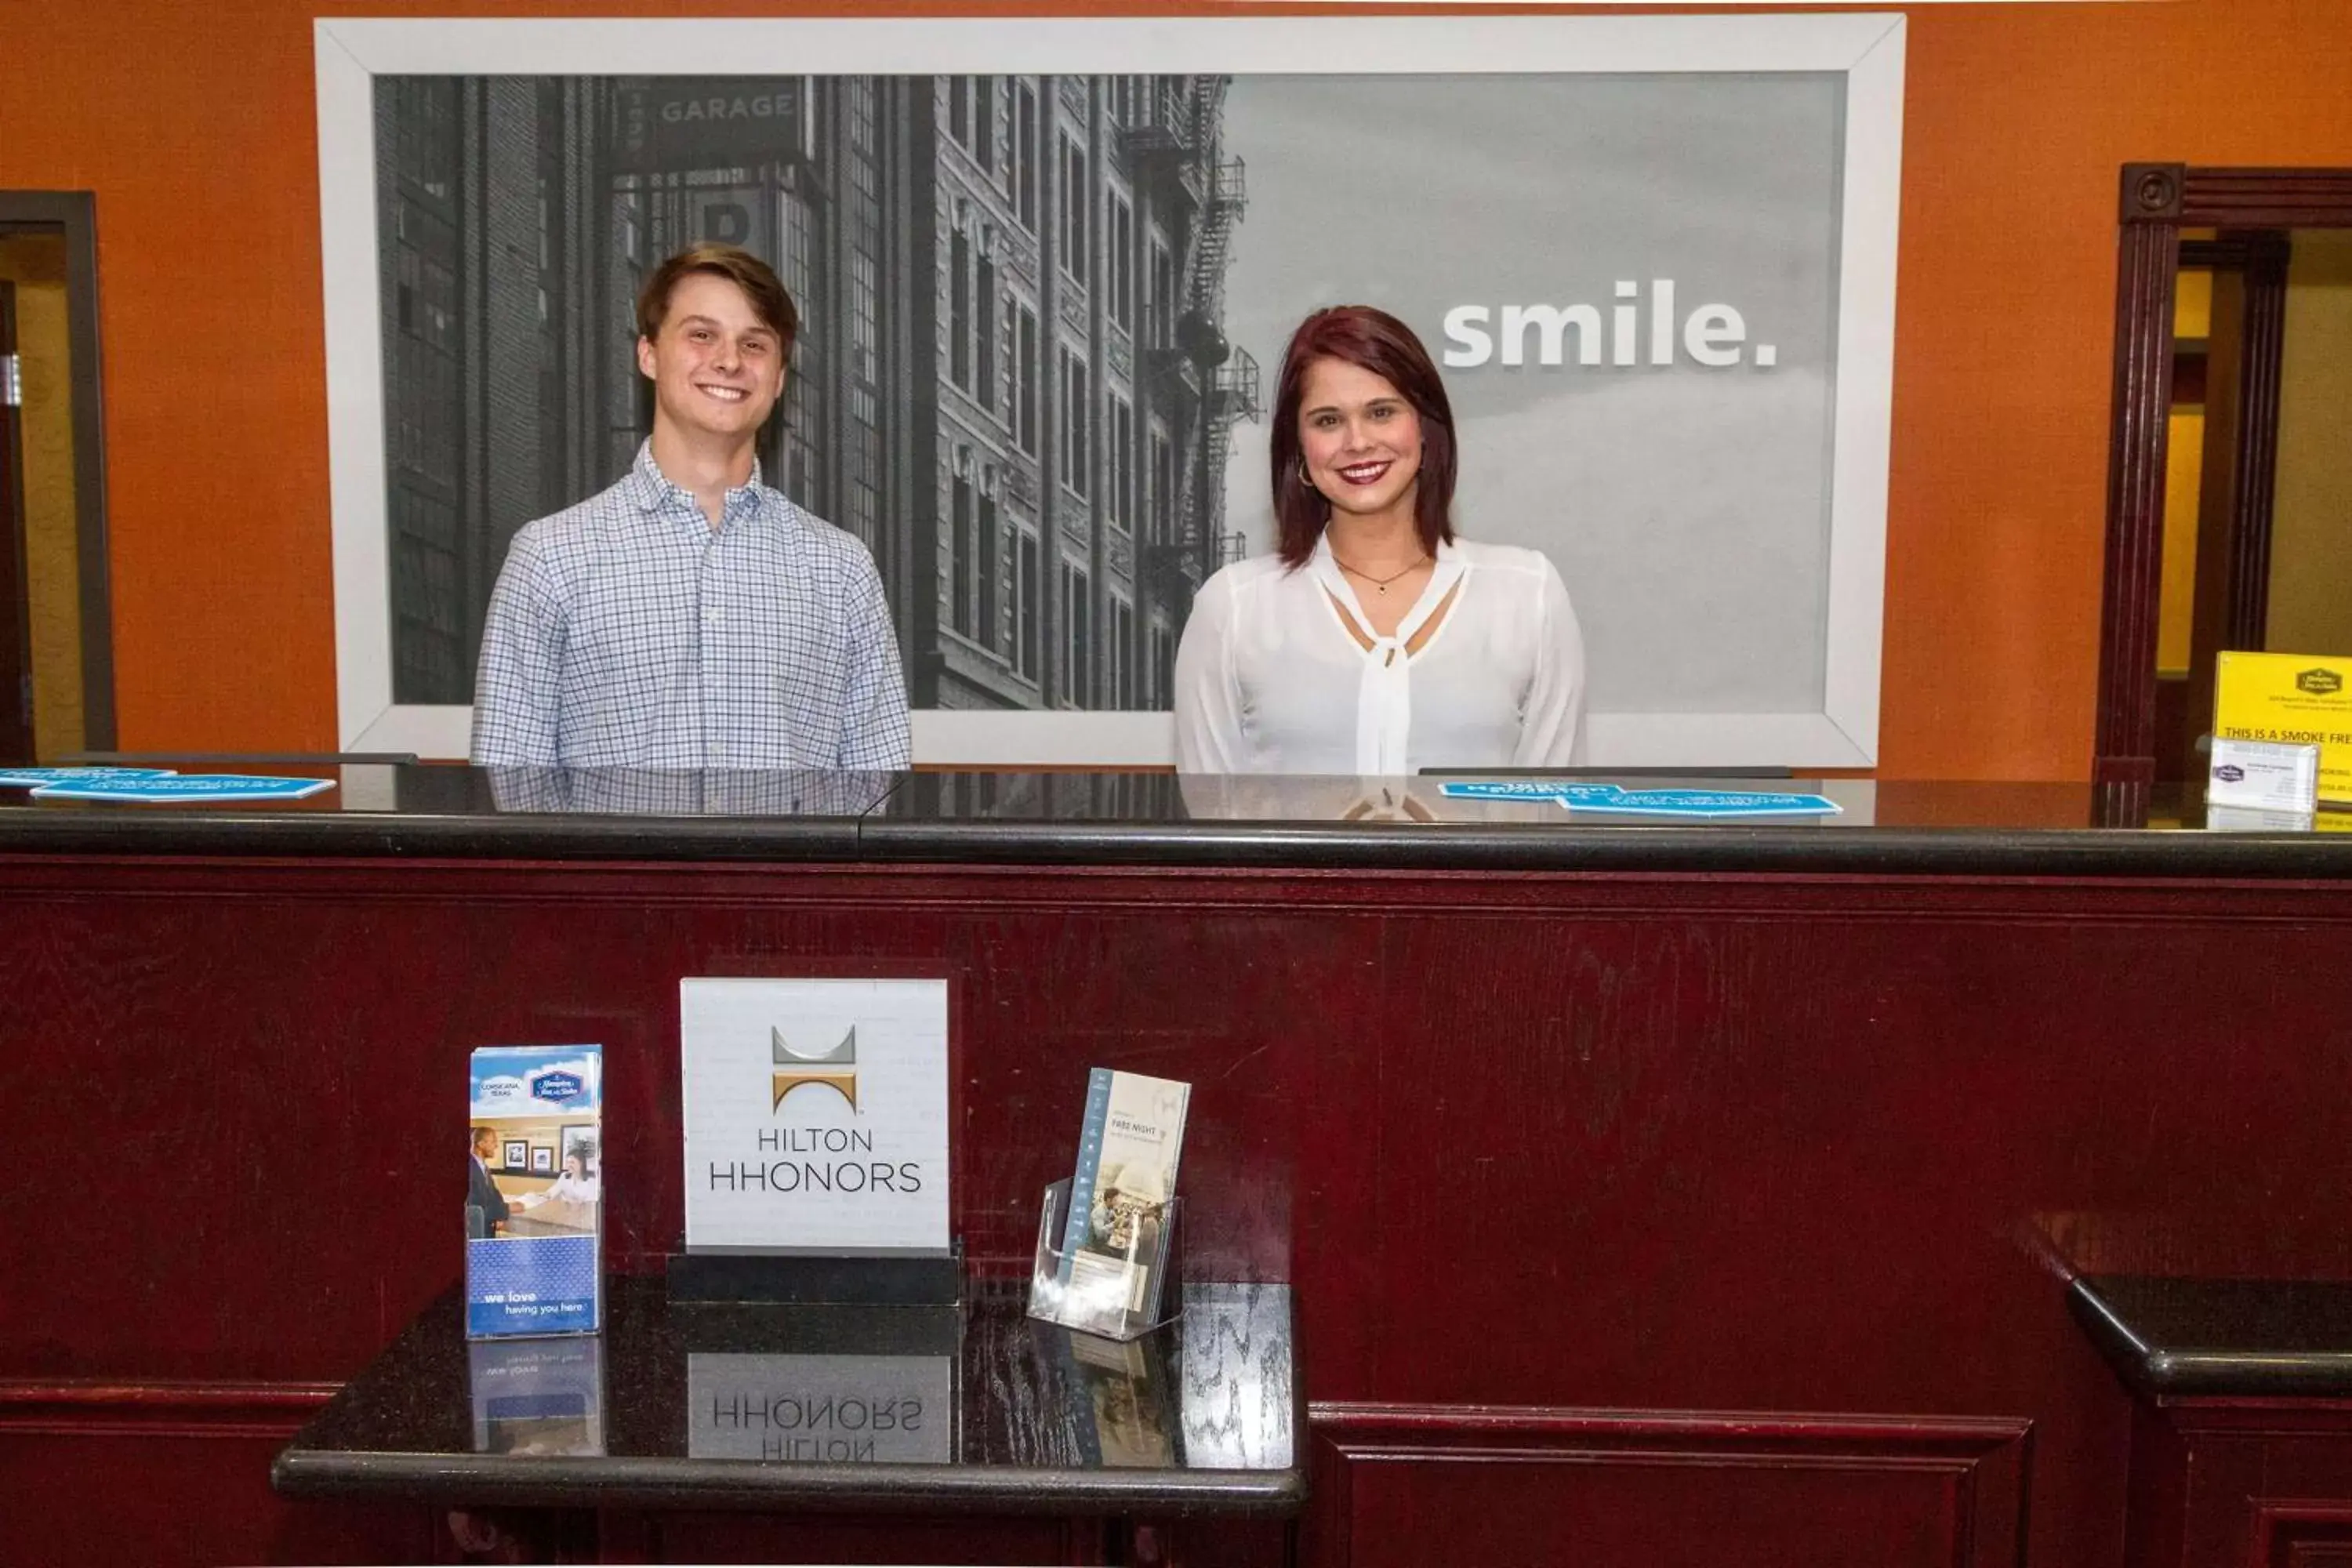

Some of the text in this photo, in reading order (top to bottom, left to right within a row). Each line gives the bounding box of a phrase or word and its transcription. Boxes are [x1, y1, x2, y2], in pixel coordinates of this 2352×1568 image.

[662, 95, 793, 122] GARAGE
[1443, 279, 1777, 368] smile.
[2225, 728, 2251, 739] THIS
[2255, 728, 2265, 739] IS
[2270, 729, 2278, 739] A
[2281, 730, 2325, 743] SMOKE
[758, 1128, 873, 1152] HILTON
[710, 1161, 921, 1192] HHONORS
[485, 1291, 536, 1303] we love
[505, 1303, 583, 1316] having you here
